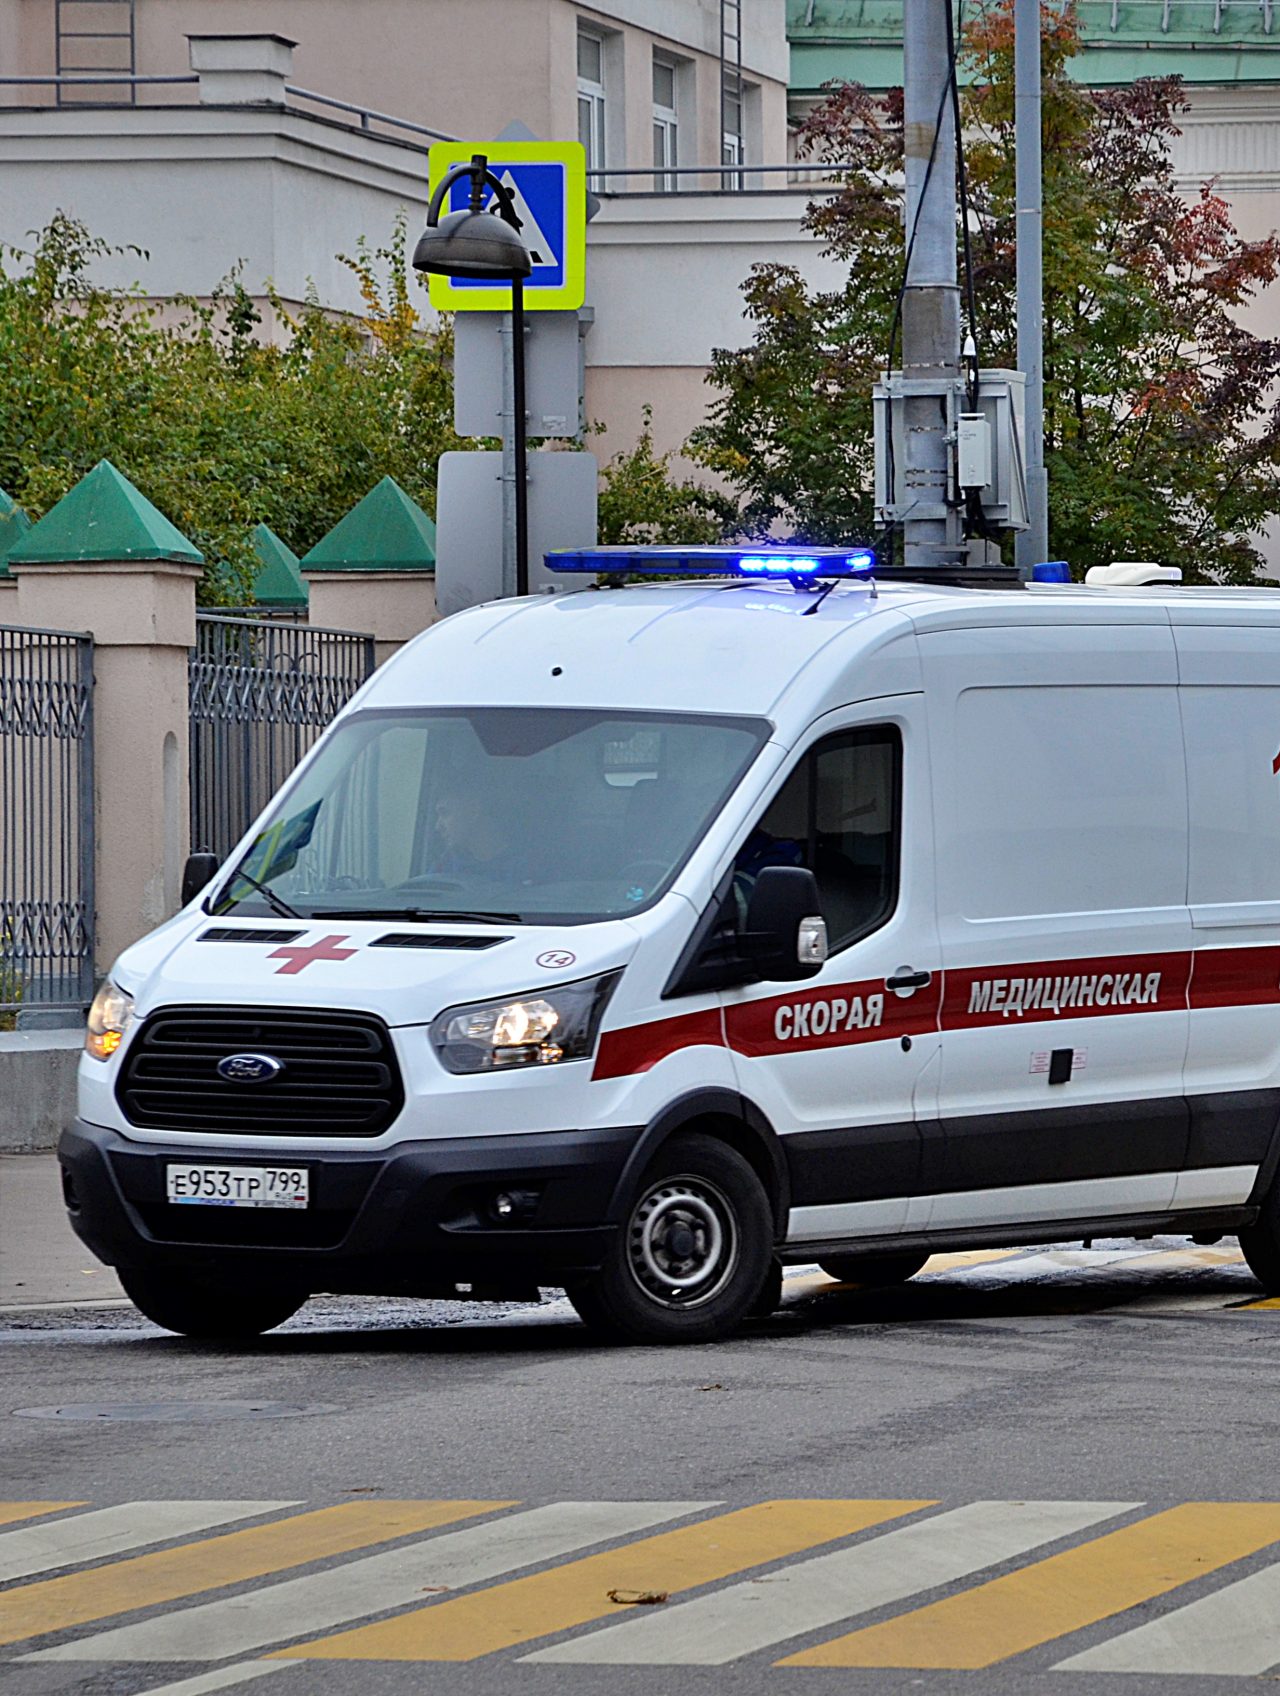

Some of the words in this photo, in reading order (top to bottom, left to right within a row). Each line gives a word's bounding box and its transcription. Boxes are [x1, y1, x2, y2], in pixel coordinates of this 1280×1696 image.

[545, 954, 570, 965] 14
[774, 993, 884, 1041] СКОРАЯ
[967, 972, 1161, 1017] МЕДИЦИНСКАЯ
[227, 1058, 263, 1076] Ford
